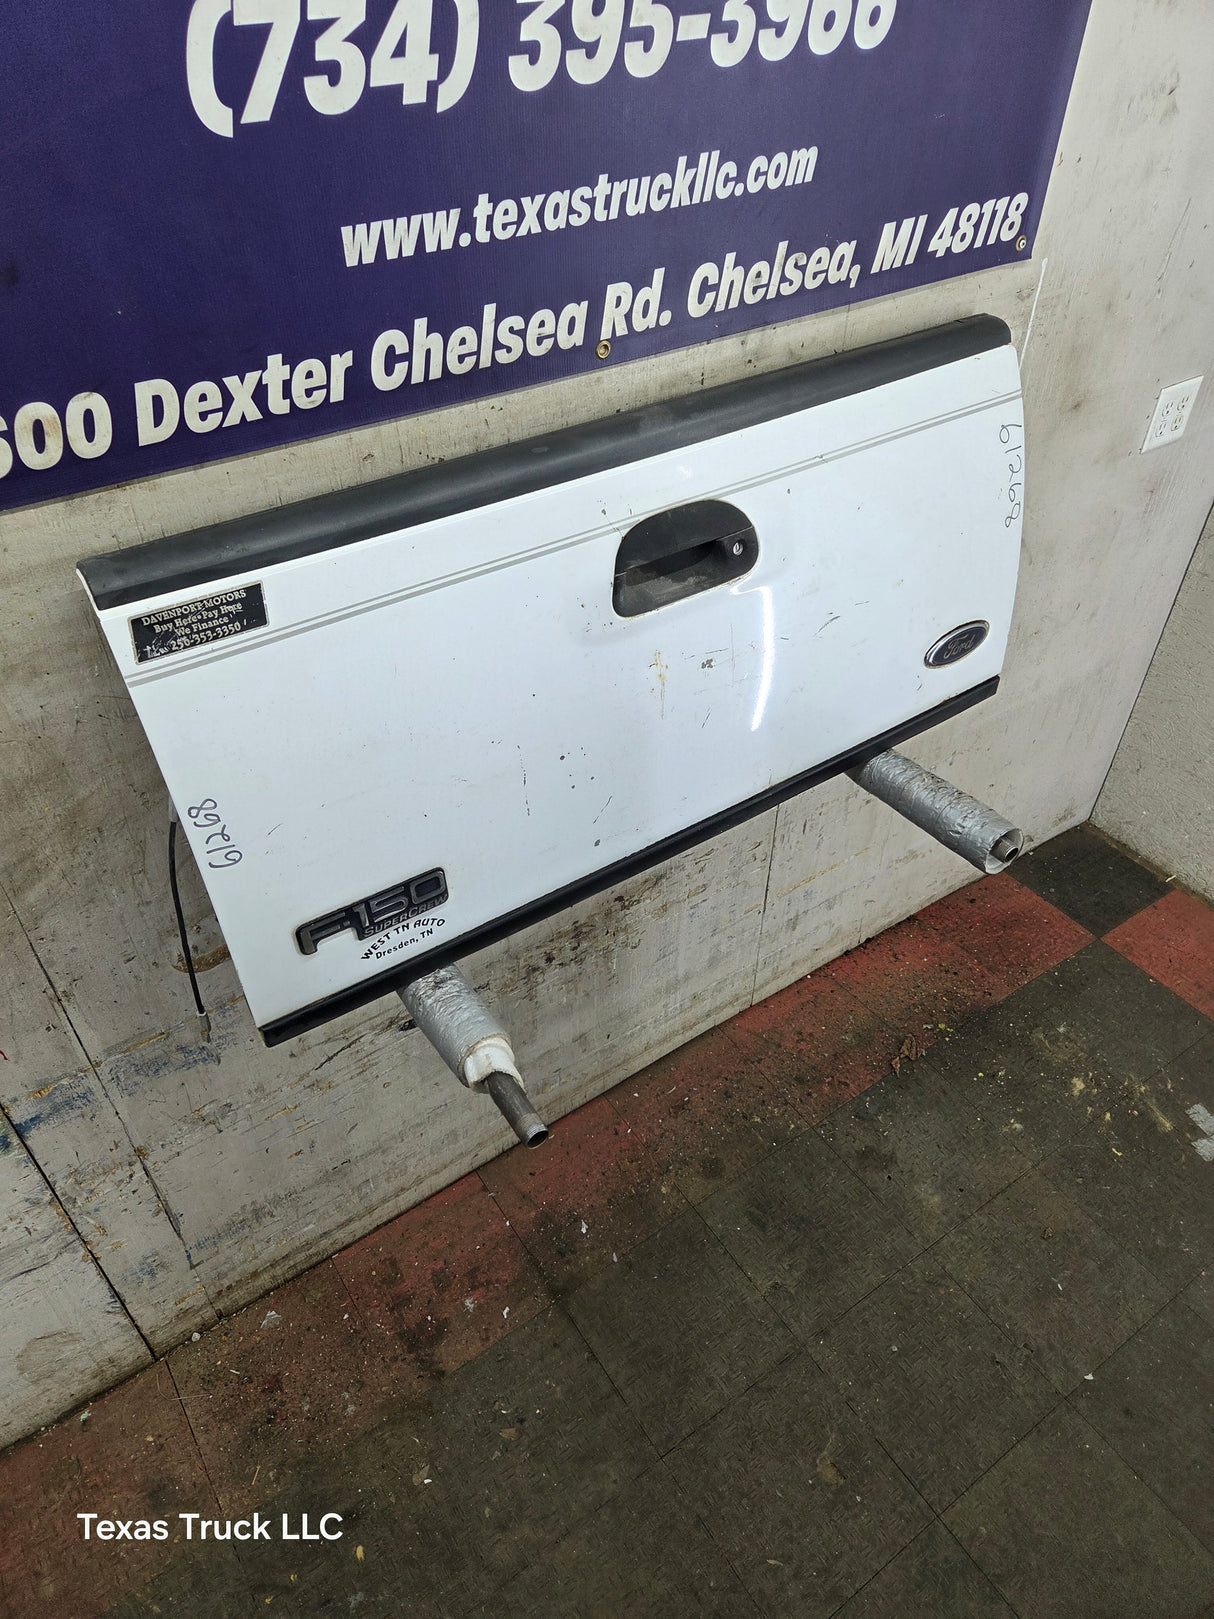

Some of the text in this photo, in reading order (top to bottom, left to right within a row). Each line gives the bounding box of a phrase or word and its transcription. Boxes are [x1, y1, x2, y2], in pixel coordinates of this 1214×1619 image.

[186, 0, 479, 138] (734)
[341, 146, 818, 267] www.texastruckllc.com
[134, 350, 353, 446] Dexter
[371, 301, 589, 392] Chelsea
[600, 268, 672, 341] Rd.
[687, 240, 857, 319] Chelsea,
[871, 214, 923, 275] MI
[928, 193, 1029, 258] 48118
[999, 424, 1022, 528] 61268
[141, 589, 247, 626] DAVENPORT MOTORS
[153, 622, 173, 634] Buy
[219, 602, 243, 615] Here
[174, 616, 229, 637] We Finance
[187, 798, 243, 869] 61268
[364, 893, 448, 936] SUPERCREW
[360, 918, 446, 960] WEST TN AUTO
[375, 928, 434, 960] Dresden, TN
